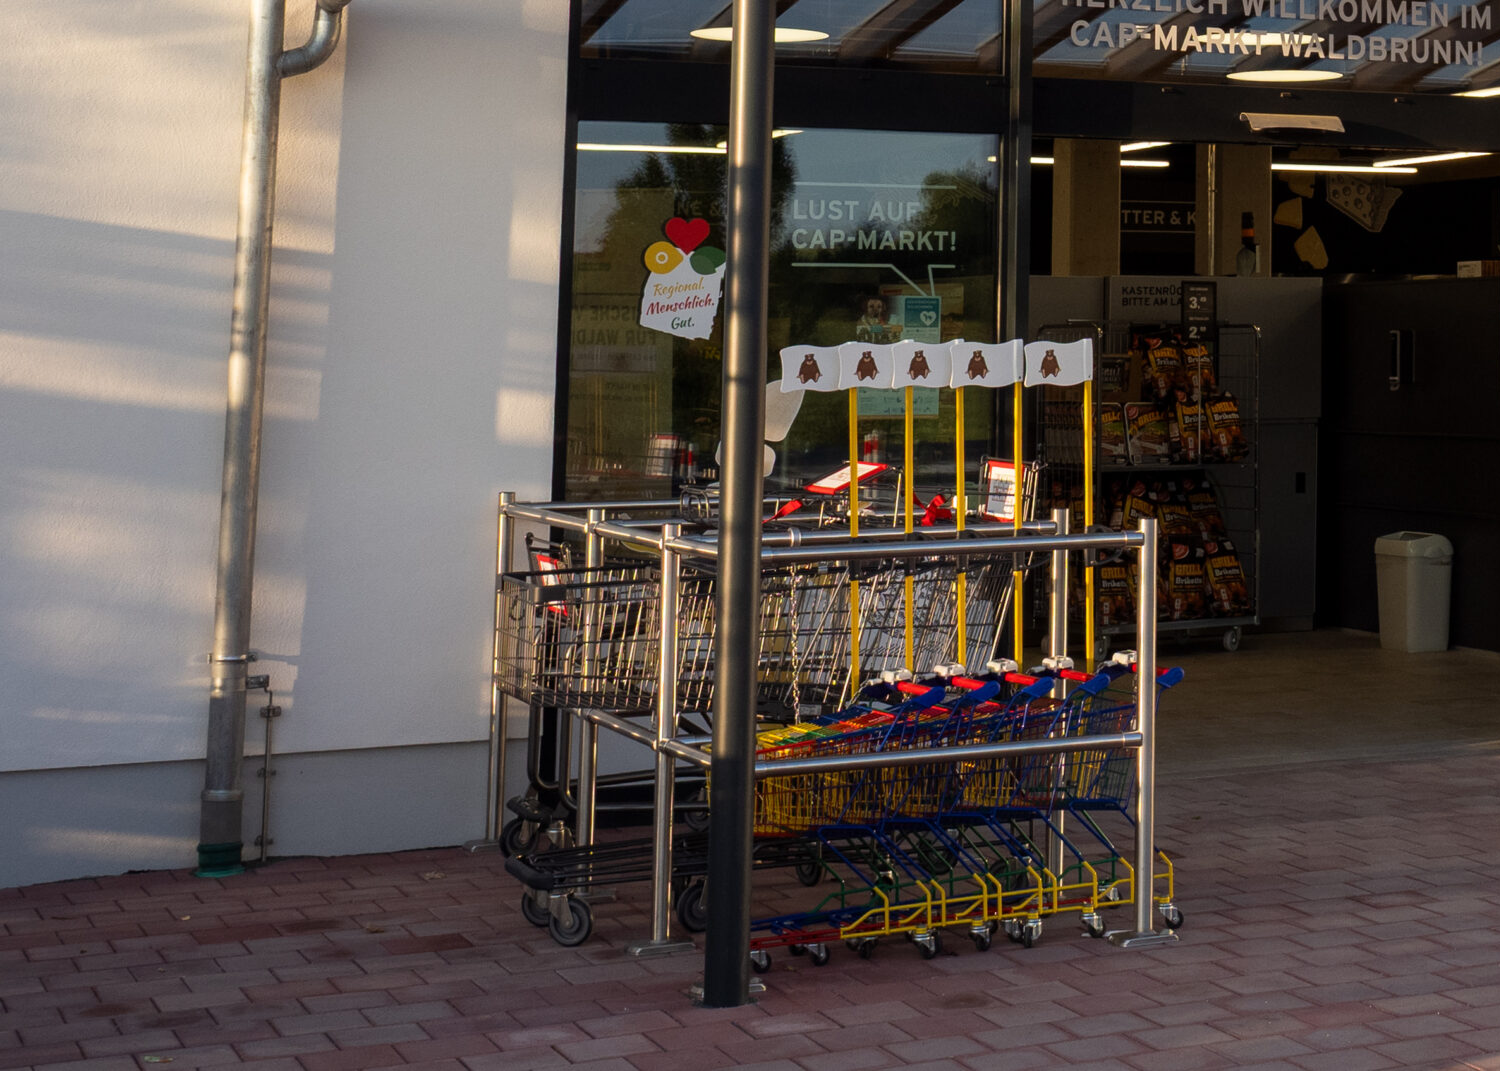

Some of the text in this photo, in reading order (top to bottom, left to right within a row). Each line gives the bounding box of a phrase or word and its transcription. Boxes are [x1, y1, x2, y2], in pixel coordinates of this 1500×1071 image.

[1462, 5, 1492, 30] IM
[1070, 20, 1484, 67] CAP-MARKT WALDBRUNN!
[793, 199, 921, 222] LUST AUF
[1121, 210, 1165, 225] TTER
[791, 228, 957, 252] CAP-MARKT!
[653, 276, 705, 299] Regional.
[1121, 283, 1182, 296] KASTENRÜC
[645, 292, 715, 316] Menschlich.
[1153, 297, 1169, 307] AM
[671, 316, 696, 330] Gut.
